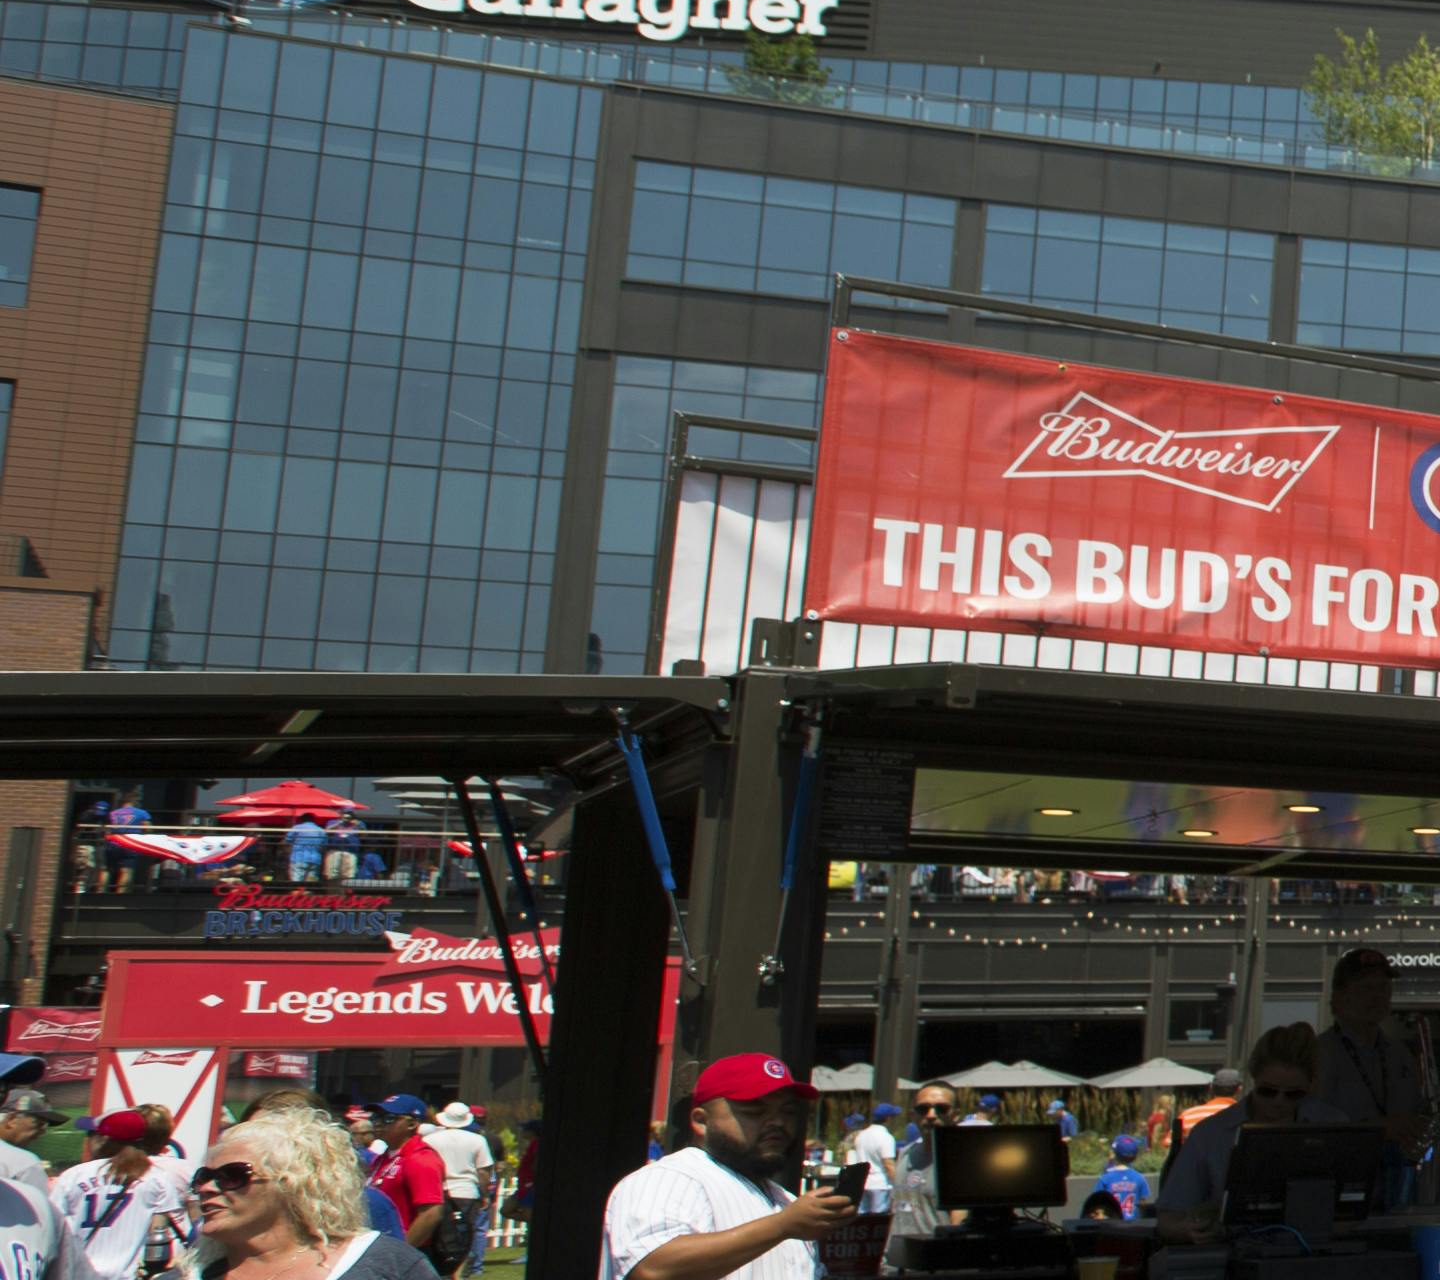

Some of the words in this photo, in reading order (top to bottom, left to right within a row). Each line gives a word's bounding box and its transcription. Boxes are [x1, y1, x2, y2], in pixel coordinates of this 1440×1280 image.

[1039, 412, 1307, 482] Budweiser
[873, 517, 1053, 601] THIS
[1076, 538, 1293, 622] BUD'S
[1312, 564, 1440, 637] FOR
[211, 881, 393, 910] Budweiser
[241, 980, 447, 1024] Legends
